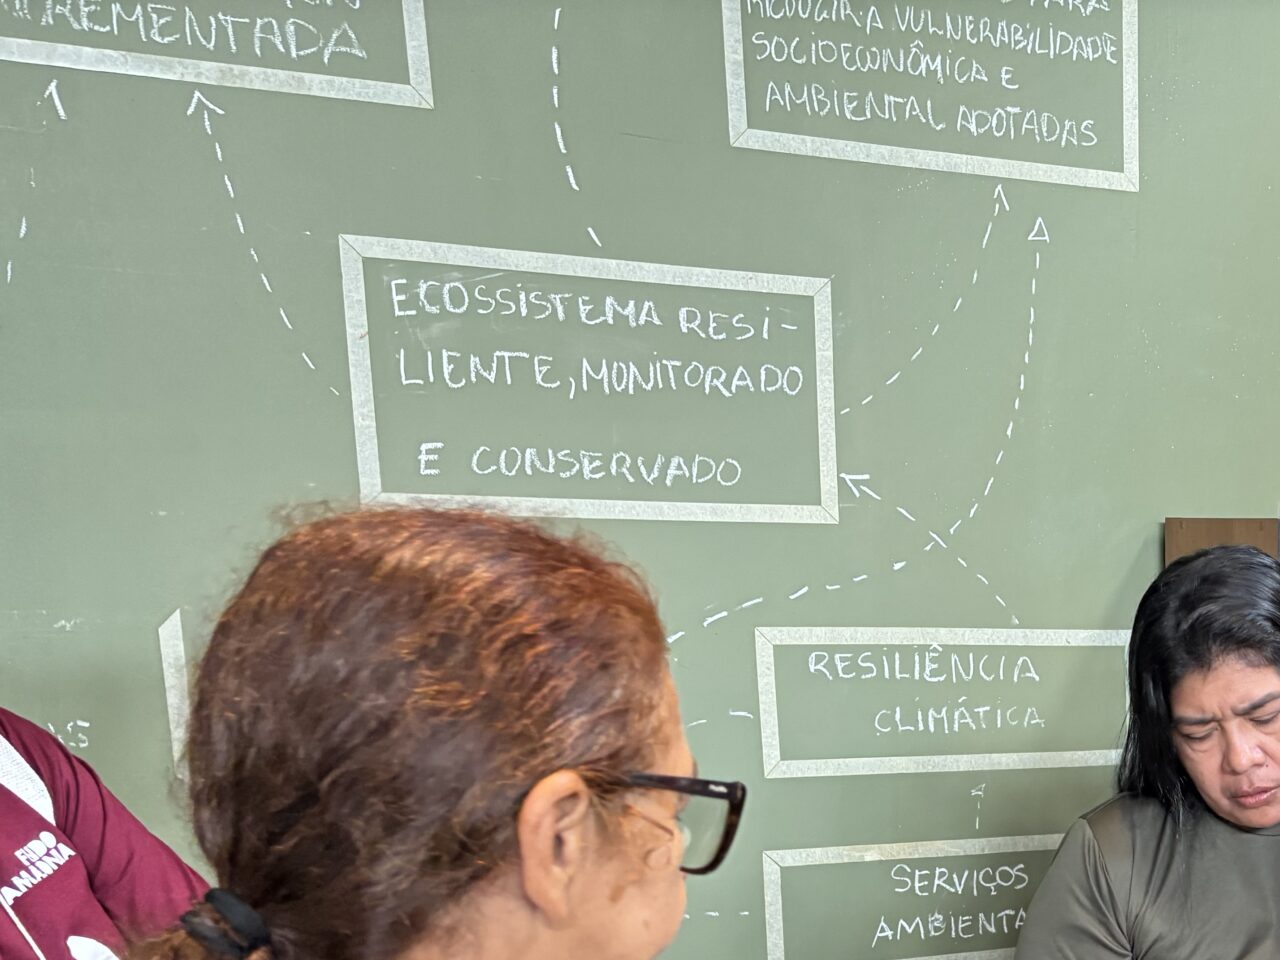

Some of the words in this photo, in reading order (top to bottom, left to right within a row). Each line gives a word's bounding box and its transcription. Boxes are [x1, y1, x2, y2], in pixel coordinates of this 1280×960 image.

[897, 6, 1119, 65] VULNERABILIDADE
[1001, 66, 1019, 89] E
[765, 80, 946, 131] AMBIENTAL
[957, 104, 1098, 147] ADOTADAS
[391, 278, 662, 327] ECOSSISTEMA
[417, 442, 444, 476] E
[471, 445, 742, 487] CONSERVADO
[807, 643, 1040, 682] RESILIÊNCIA
[874, 697, 1046, 735] CLIMÁTICA
[891, 863, 1029, 896] SERVIÇOS
[871, 907, 1026, 948] AMBIENTA
